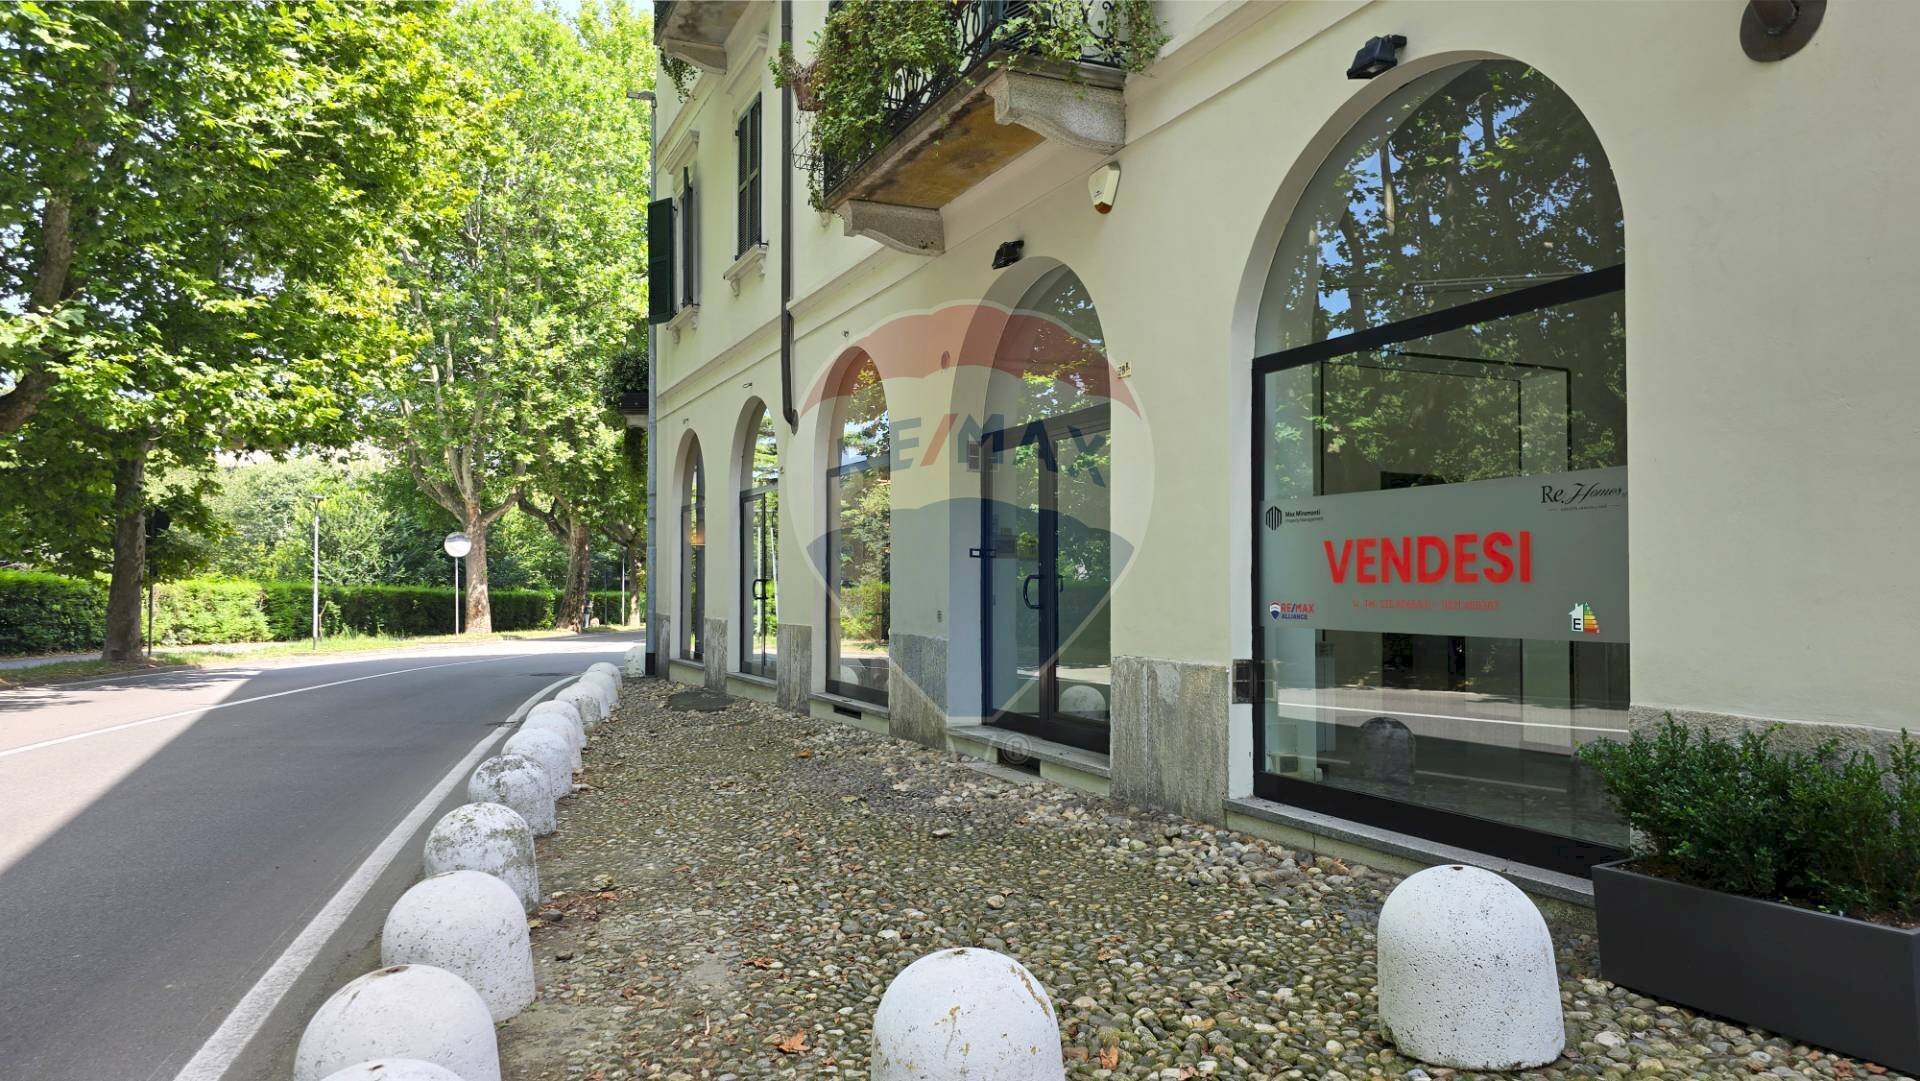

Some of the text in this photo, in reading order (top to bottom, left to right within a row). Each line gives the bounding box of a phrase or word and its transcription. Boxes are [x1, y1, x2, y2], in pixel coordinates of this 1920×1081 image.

[1323, 530, 1533, 585] VENDESI
[1280, 602, 1314, 613] RE/MAX
[1573, 618, 1582, 630] E
